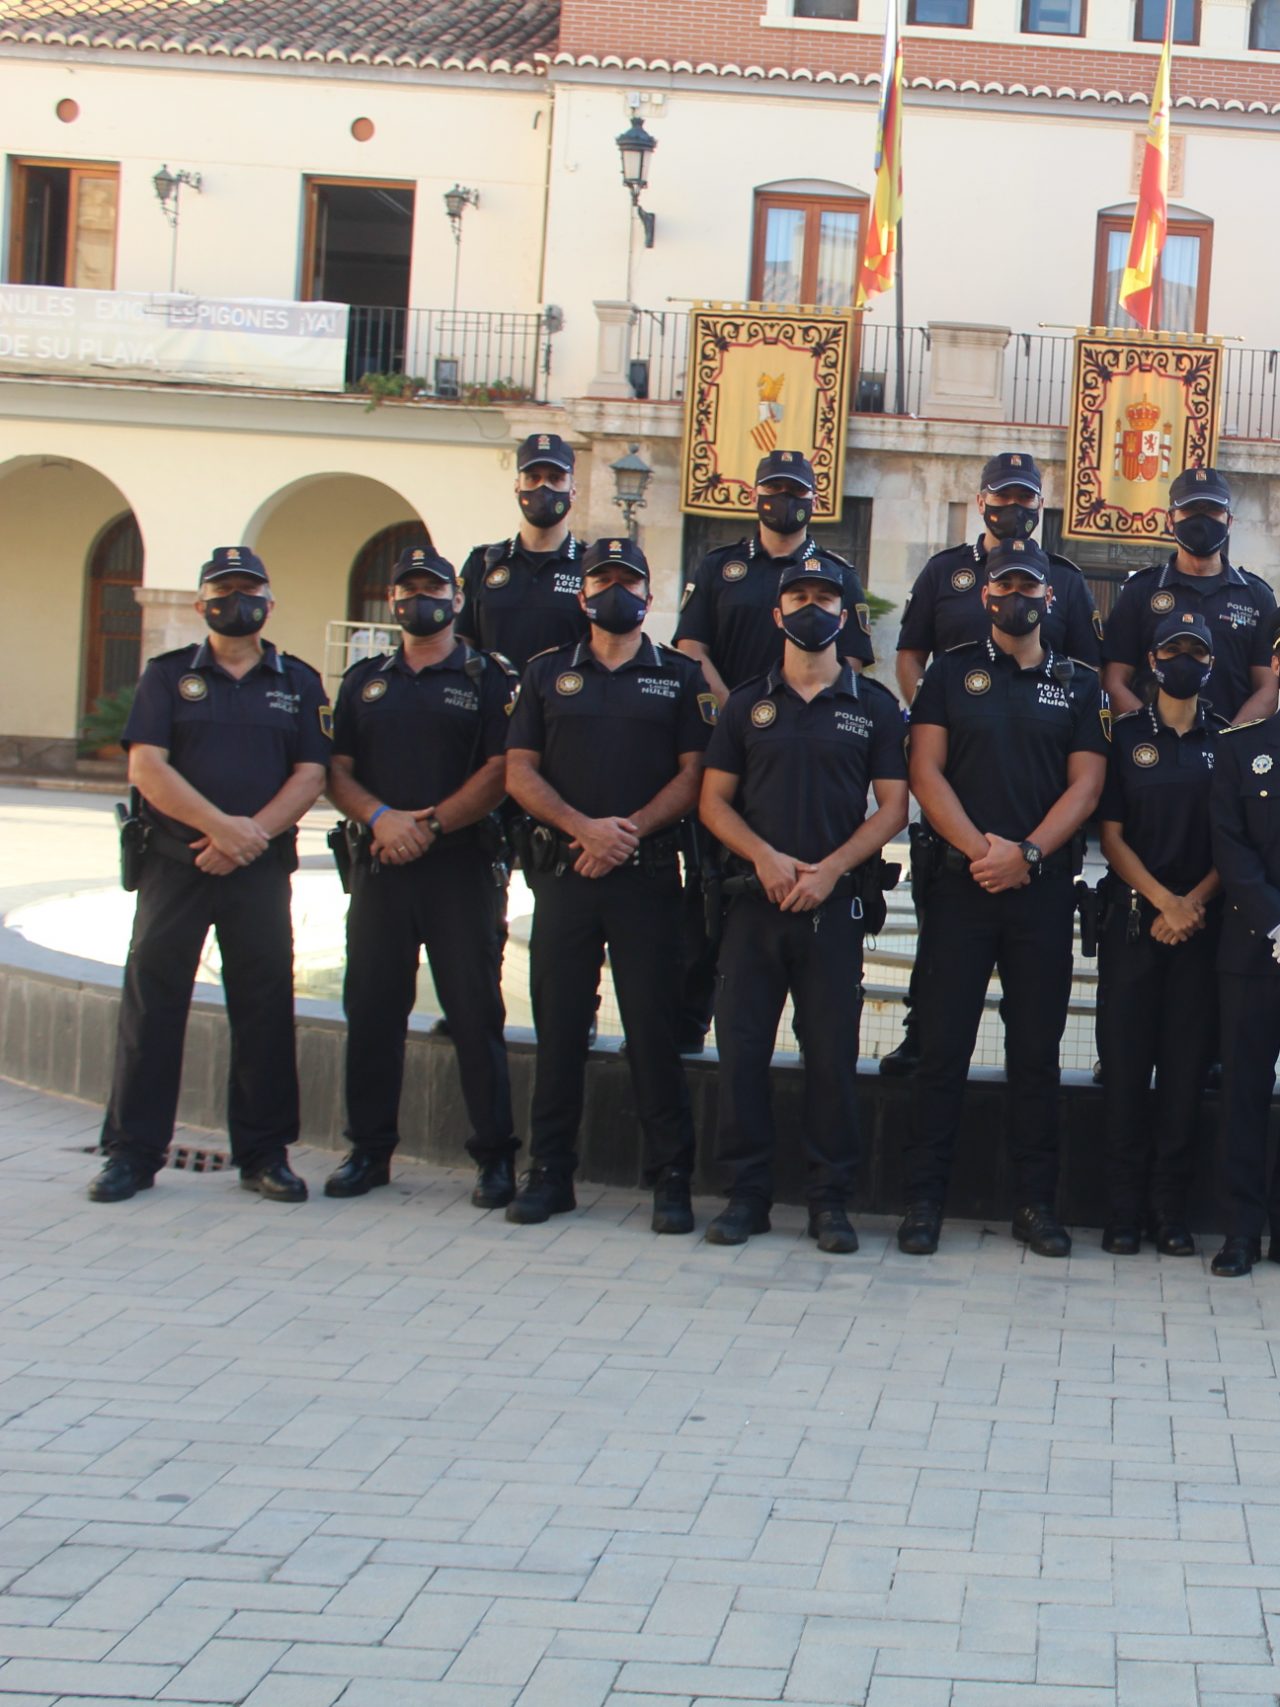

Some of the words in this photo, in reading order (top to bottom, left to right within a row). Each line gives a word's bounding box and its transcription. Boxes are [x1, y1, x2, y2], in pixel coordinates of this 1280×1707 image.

[0, 294, 76, 317] NULES
[169, 302, 289, 330] ESPIGONES
[35, 336, 71, 360] SU
[78, 338, 159, 366] PLAYA
[553, 572, 582, 583] POLIC
[555, 580, 581, 588] LOCA
[553, 586, 582, 595] Nule
[1226, 602, 1260, 617] POLICA
[637, 677, 681, 688] POLICIA
[641, 687, 676, 698] NULES
[1037, 683, 1075, 699] POLIA
[1040, 690, 1065, 700] LOCA
[834, 711, 873, 727] POLICIA
[837, 722, 869, 738] NULES
